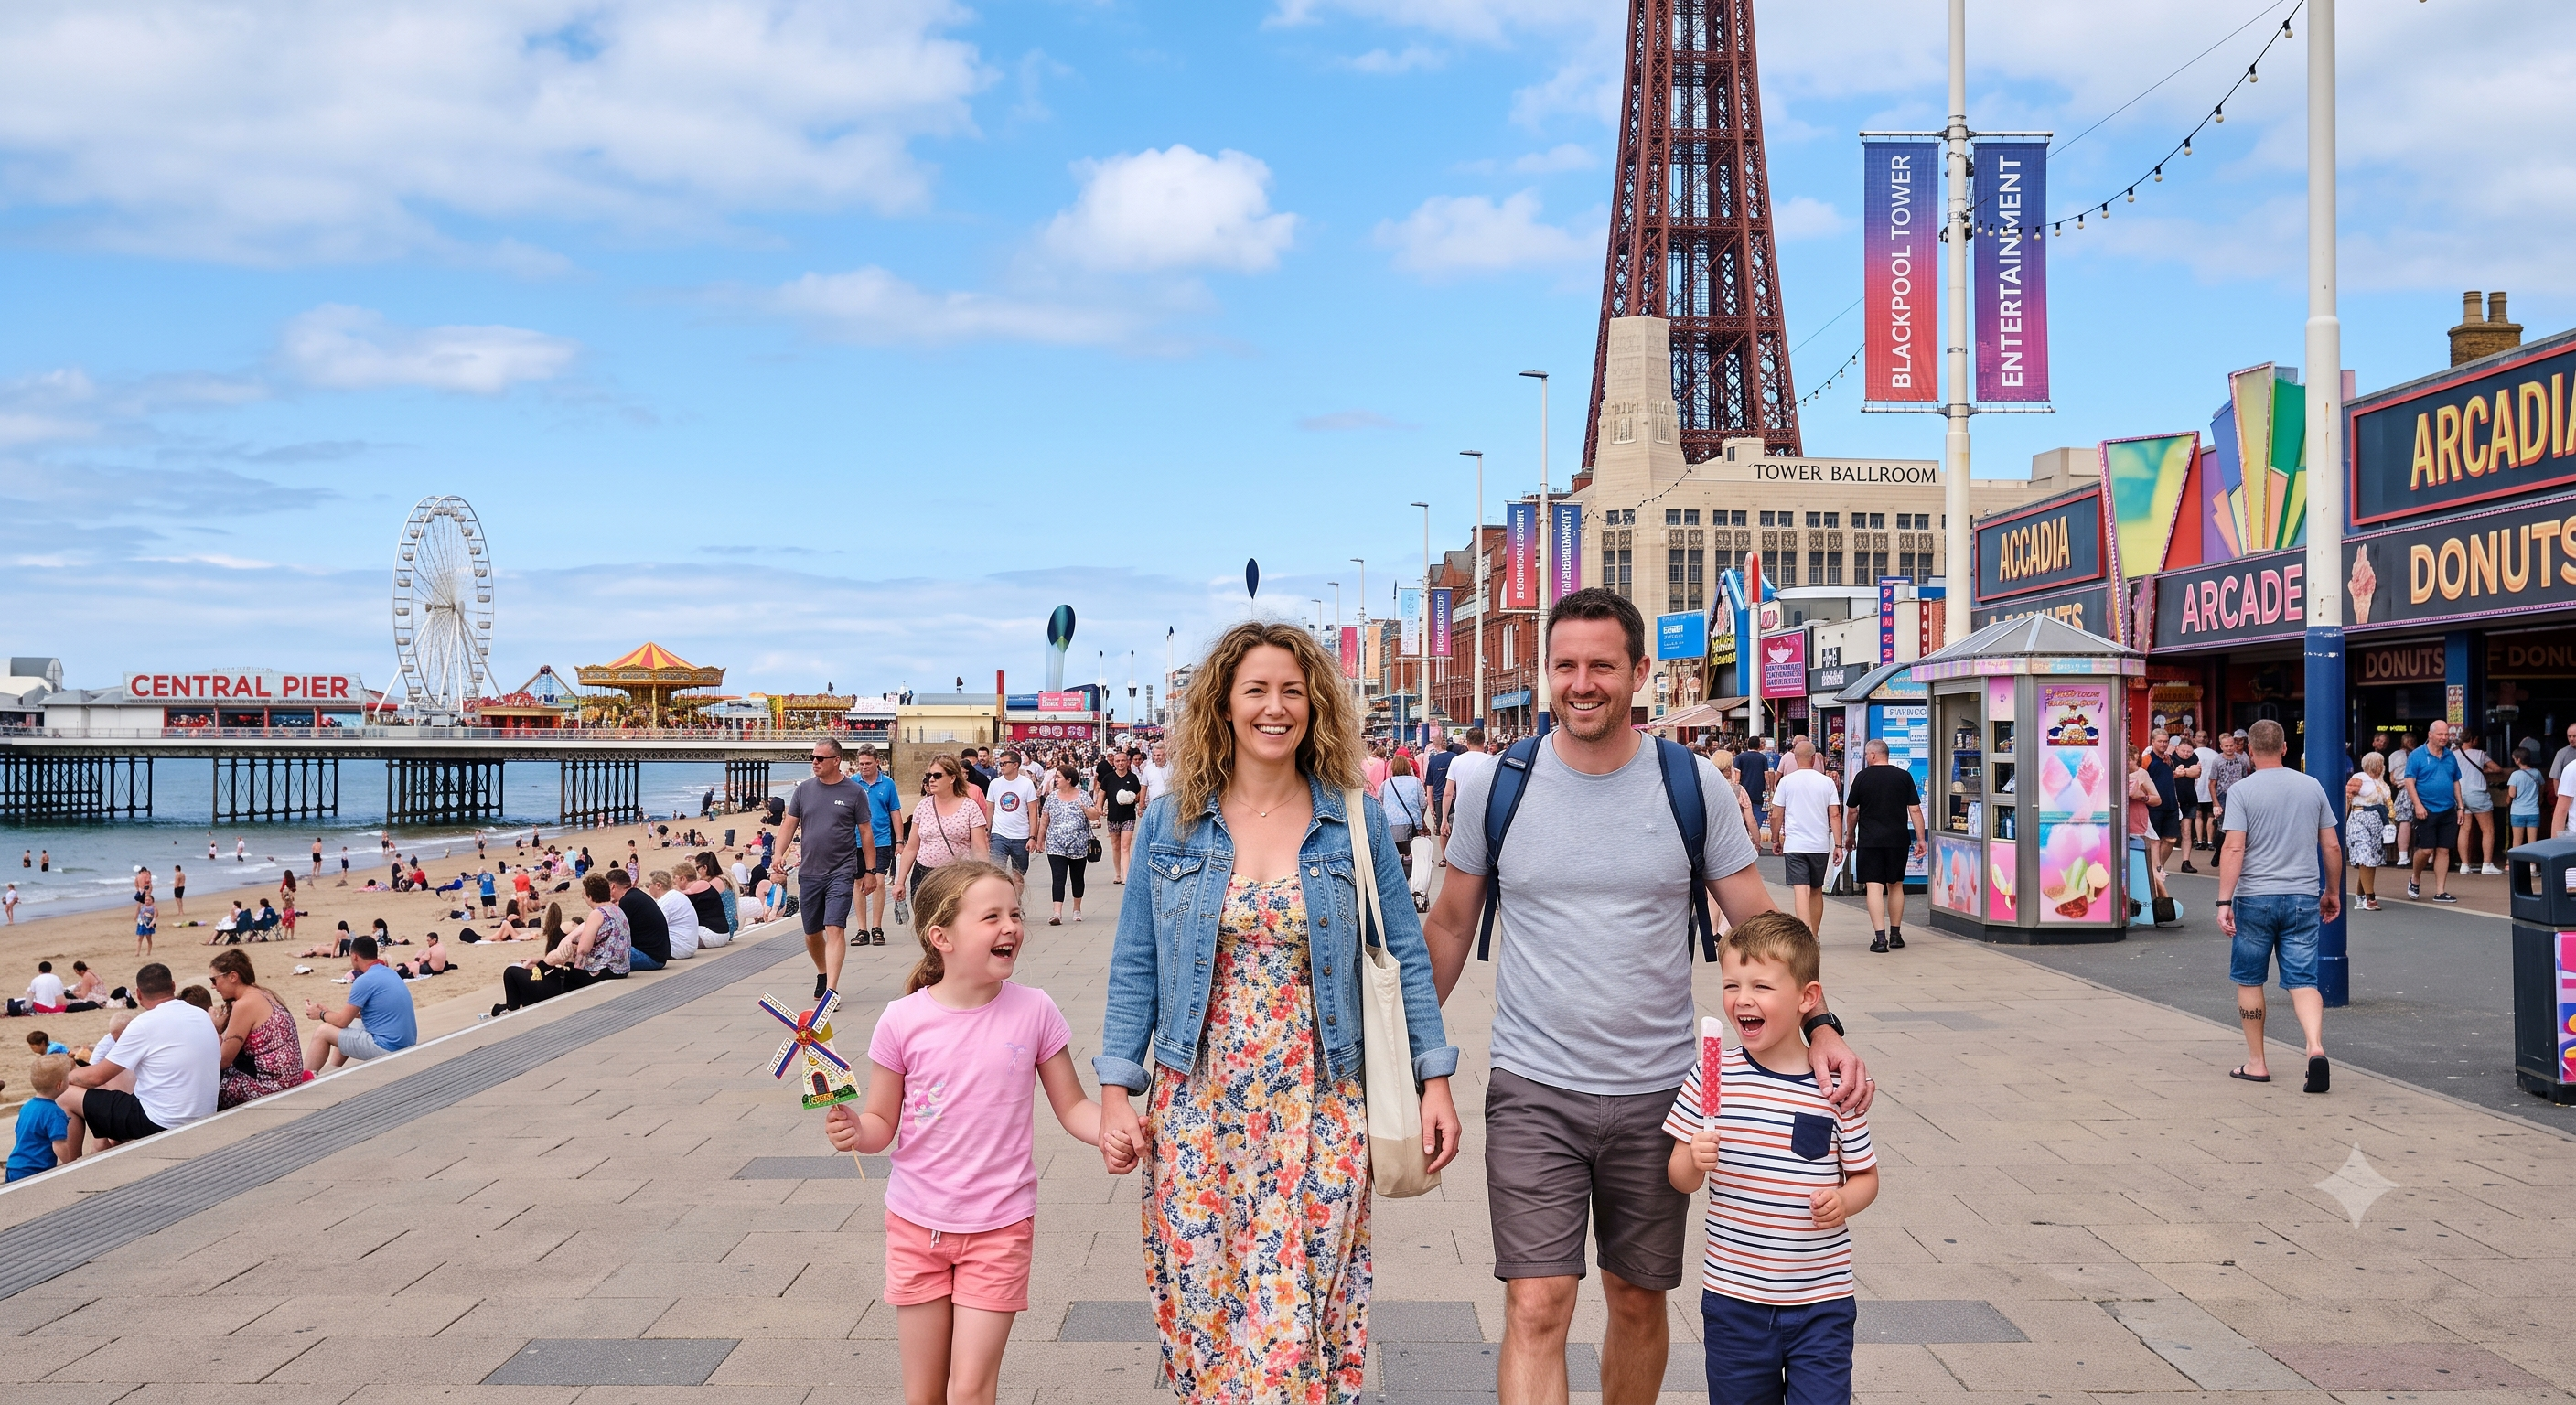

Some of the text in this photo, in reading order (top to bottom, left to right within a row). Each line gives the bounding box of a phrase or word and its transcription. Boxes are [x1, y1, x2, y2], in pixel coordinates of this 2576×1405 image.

[1891, 155, 1912, 388] BLACKPOOL TOWER
[1999, 155, 2023, 387] ENTERTAINMENT
[1754, 464, 1937, 484] TOWER BALLROOM
[1999, 515, 2072, 583] ACCADIA
[2181, 563, 2303, 634] ARCADE
[131, 674, 349, 699] CENTRAL PIER
[2365, 647, 2445, 679] DONUTS
